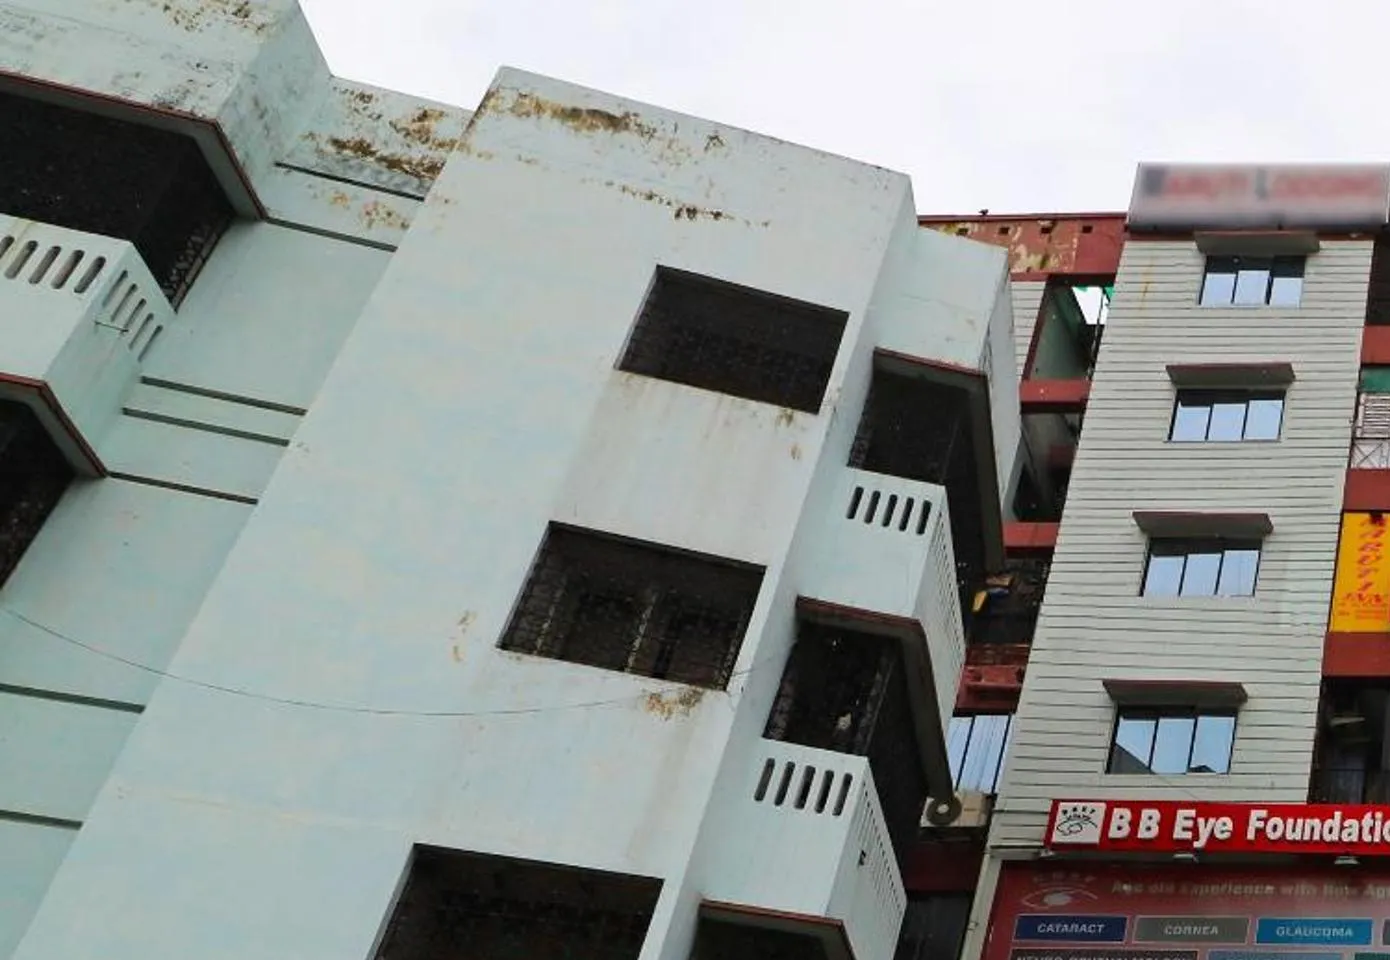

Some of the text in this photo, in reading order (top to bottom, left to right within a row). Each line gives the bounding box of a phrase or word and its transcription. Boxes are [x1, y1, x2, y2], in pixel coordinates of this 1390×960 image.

[1173, 809, 1233, 848] Eye
[1037, 923, 1106, 934] CATARACT
[1164, 925, 1219, 936] CORNEA
[1276, 925, 1354, 938] GLAUCOMA
